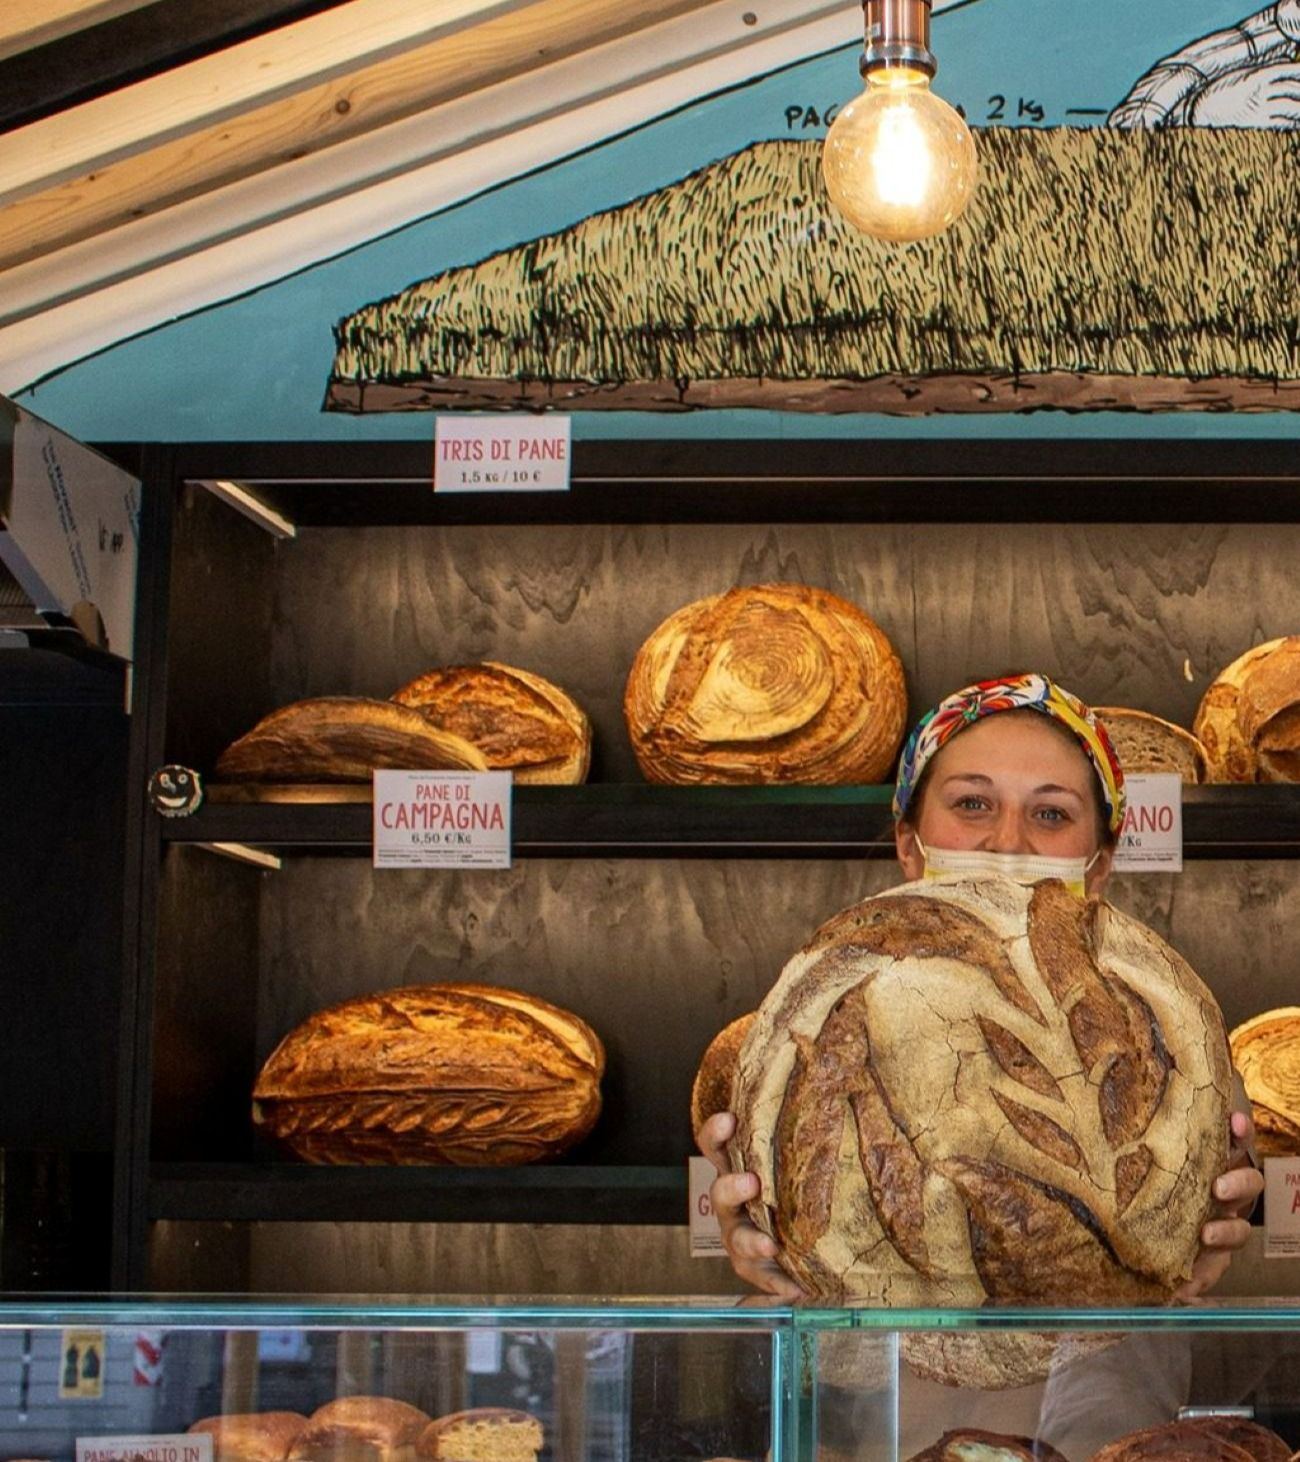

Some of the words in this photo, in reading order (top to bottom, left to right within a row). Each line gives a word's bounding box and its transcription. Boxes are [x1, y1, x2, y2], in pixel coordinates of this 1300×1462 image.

[986, 95, 1005, 120] 2
[1018, 97, 1044, 122] Kg
[441, 440, 483, 461] TRIS
[491, 440, 511, 461] DI
[518, 439, 566, 460] PANE
[513, 471, 528, 483] 10
[533, 471, 541, 482] €
[416, 784, 450, 801] PANE
[455, 784, 471, 801] DI
[381, 802, 504, 830] CAMPAGNA
[411, 833, 440, 845] 6,50
